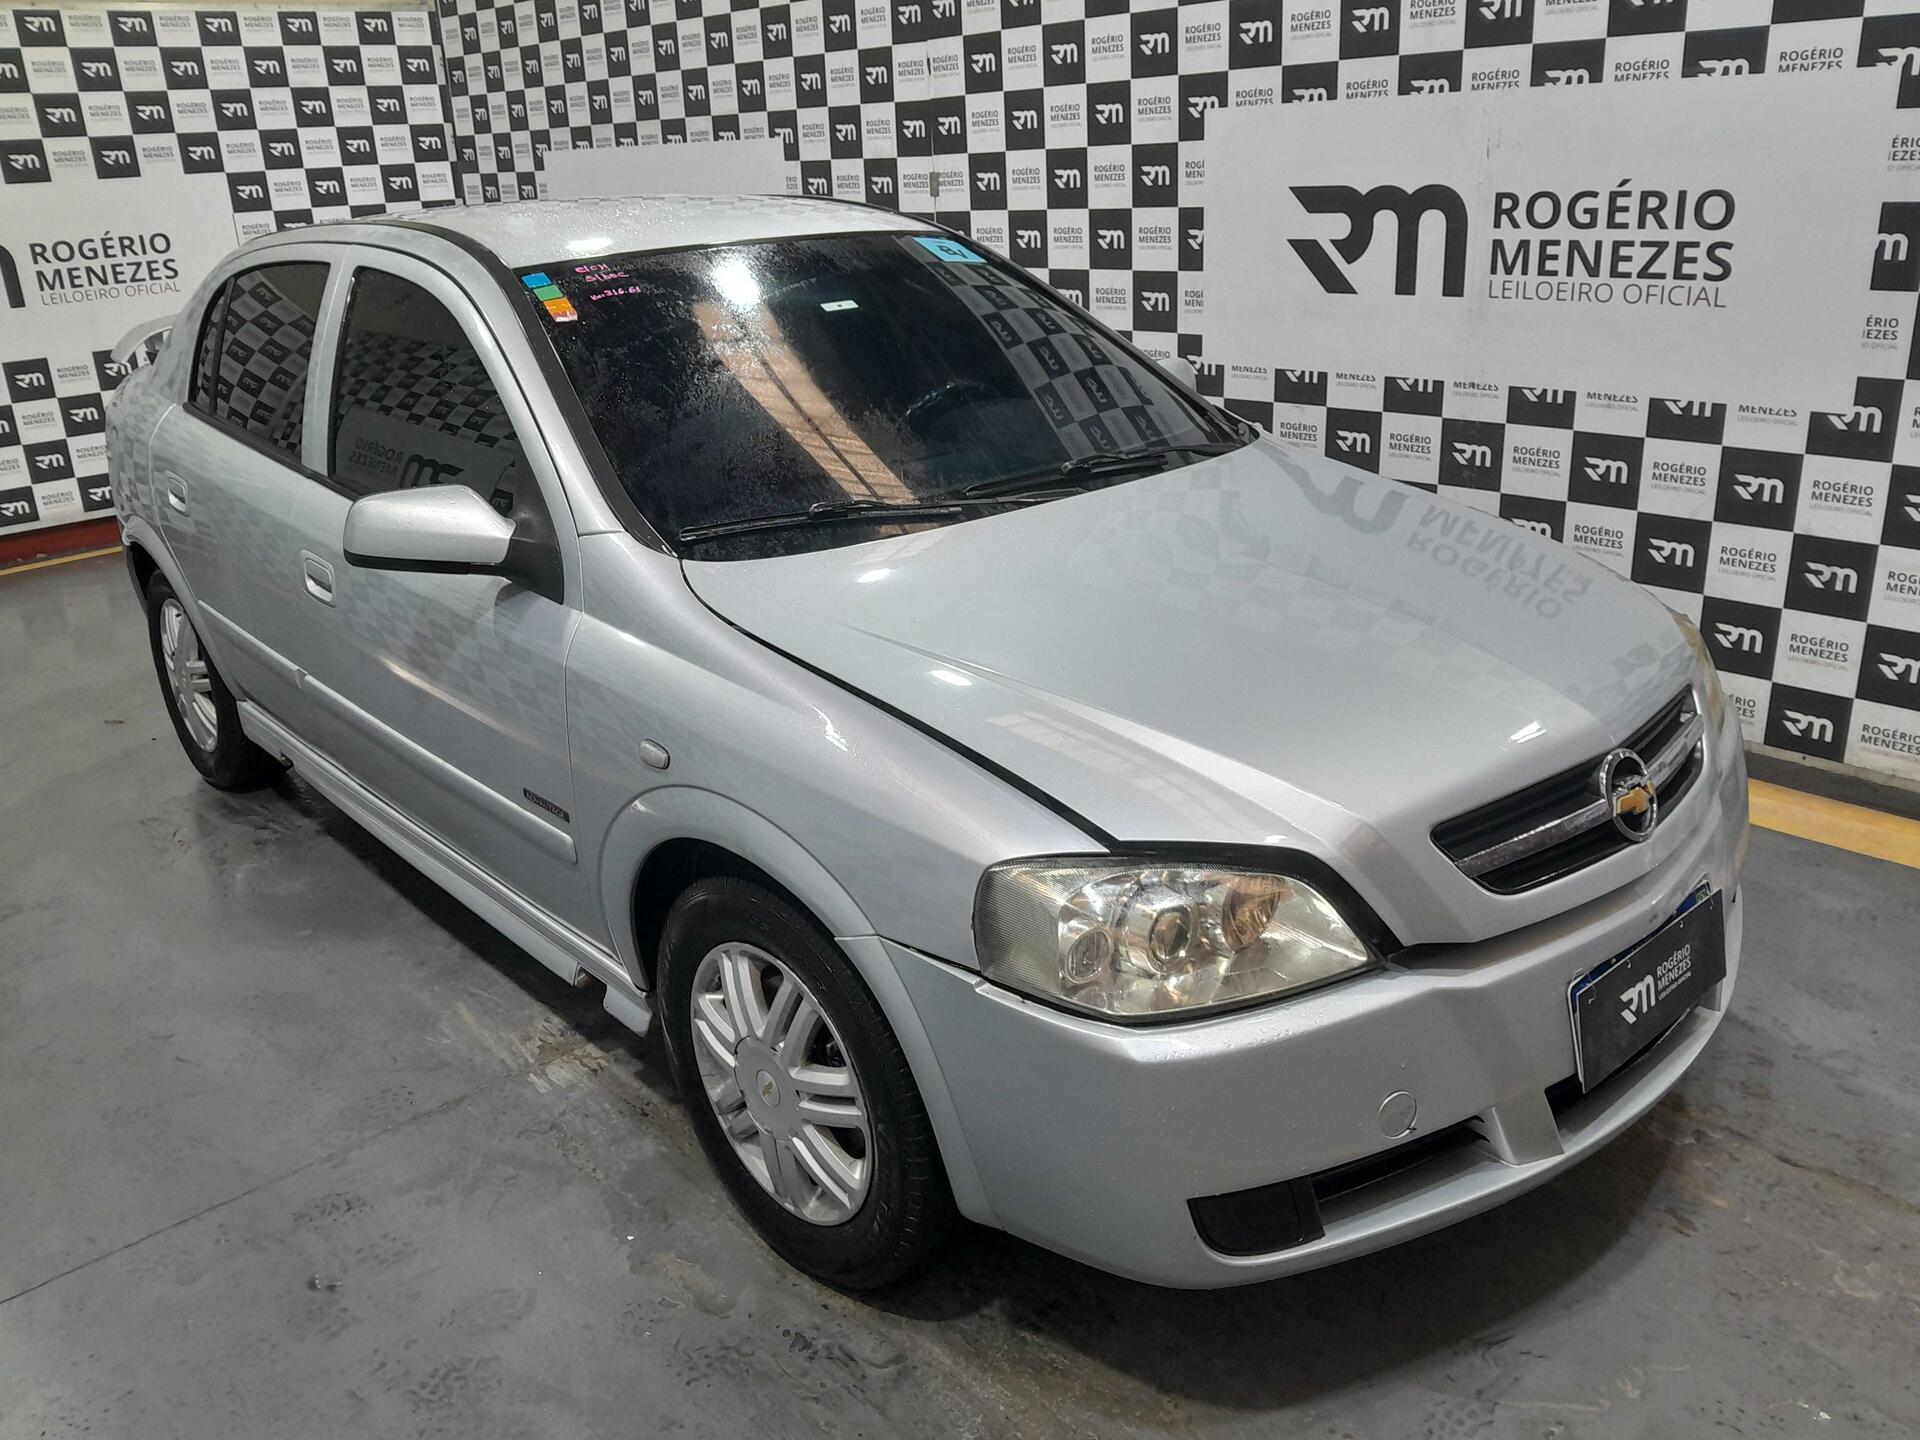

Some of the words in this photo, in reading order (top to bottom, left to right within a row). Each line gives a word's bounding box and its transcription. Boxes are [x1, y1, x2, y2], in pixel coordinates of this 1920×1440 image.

[1291, 10, 1331, 22] ROGÉRIO
[1410, 7, 1456, 20] MENEZES
[1291, 20, 1331, 32] MENEZES
[1185, 32, 1221, 44] MENEZES
[1092, 43, 1124, 54] MENEZES
[1008, 54, 1037, 63] MENEZES
[1050, 112, 1080, 121] MENEZES
[1138, 106, 1171, 115] MENEZES
[1094, 173, 1125, 181] MENEZES
[1492, 178, 1736, 230] ROGÉRIO
[29, 231, 171, 264] ROGÉRIO
[1490, 238, 1734, 282] MENEZES
[36, 258, 179, 292] MENEZES
[41, 288, 120, 306] LEILOEIRO
[125, 281, 182, 297] OFICIAL
[1096, 296, 1126, 304] MENEZES
[1488, 279, 1614, 303] LEILOEIRO
[1623, 283, 1727, 308] OFICIAL
[1280, 422, 1317, 432] ROGÉRIO
[1280, 431, 1317, 441] MENEZES
[1390, 433, 1431, 444] ROGÉRIO
[1389, 442, 1431, 454] MENEZES
[1513, 446, 1560, 459] ROGÉRIO
[1512, 456, 1560, 469] MENEZES
[1653, 462, 1706, 476] ROGÉRIO
[1652, 472, 1705, 486] MENEZES
[1813, 480, 1873, 496] ROGÉRIO
[1811, 491, 1872, 507] MENEZES
[1575, 524, 1623, 539] ROGÉRIO
[1574, 534, 1623, 549] MENEZES
[1721, 546, 1776, 562] ROGÉRIO
[1720, 556, 1776, 573] MENEZES
[1791, 634, 1849, 652] ROGÉRIO
[1789, 644, 1848, 662] MENEZES
[1657, 944, 1691, 978] ROGÉRIO
[1658, 956, 1691, 990] MENEZES
